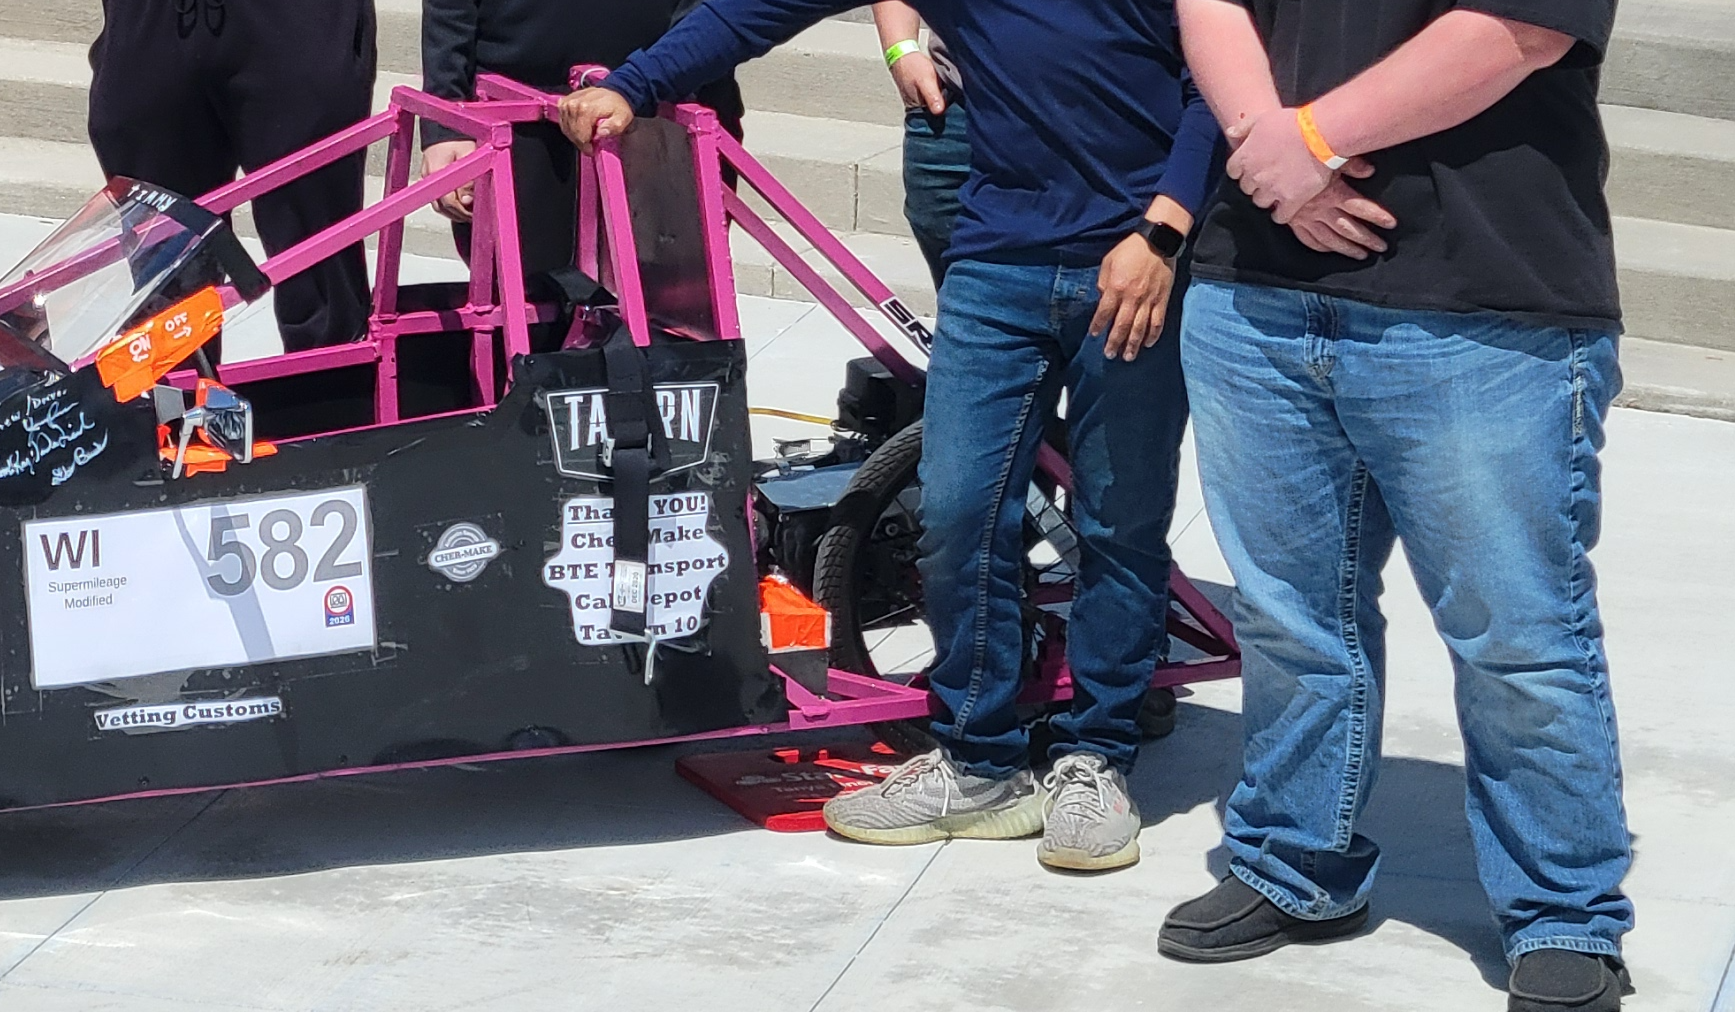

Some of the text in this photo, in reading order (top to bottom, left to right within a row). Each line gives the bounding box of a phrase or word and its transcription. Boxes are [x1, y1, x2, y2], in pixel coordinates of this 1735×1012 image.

[165, 312, 188, 332] OFF
[564, 388, 701, 452] TARN
[568, 495, 707, 522] Tha YOU!
[39, 499, 363, 597] WI 582
[434, 545, 493, 563] CHER-MAKE
[548, 562, 599, 581] BTE
[47, 572, 128, 595] Supermileage
[63, 593, 114, 610] Modified
[650, 585, 702, 607] epot
[328, 615, 351, 626] 2026
[674, 615, 699, 634] 10
[95, 697, 282, 729] Vetting Customs
